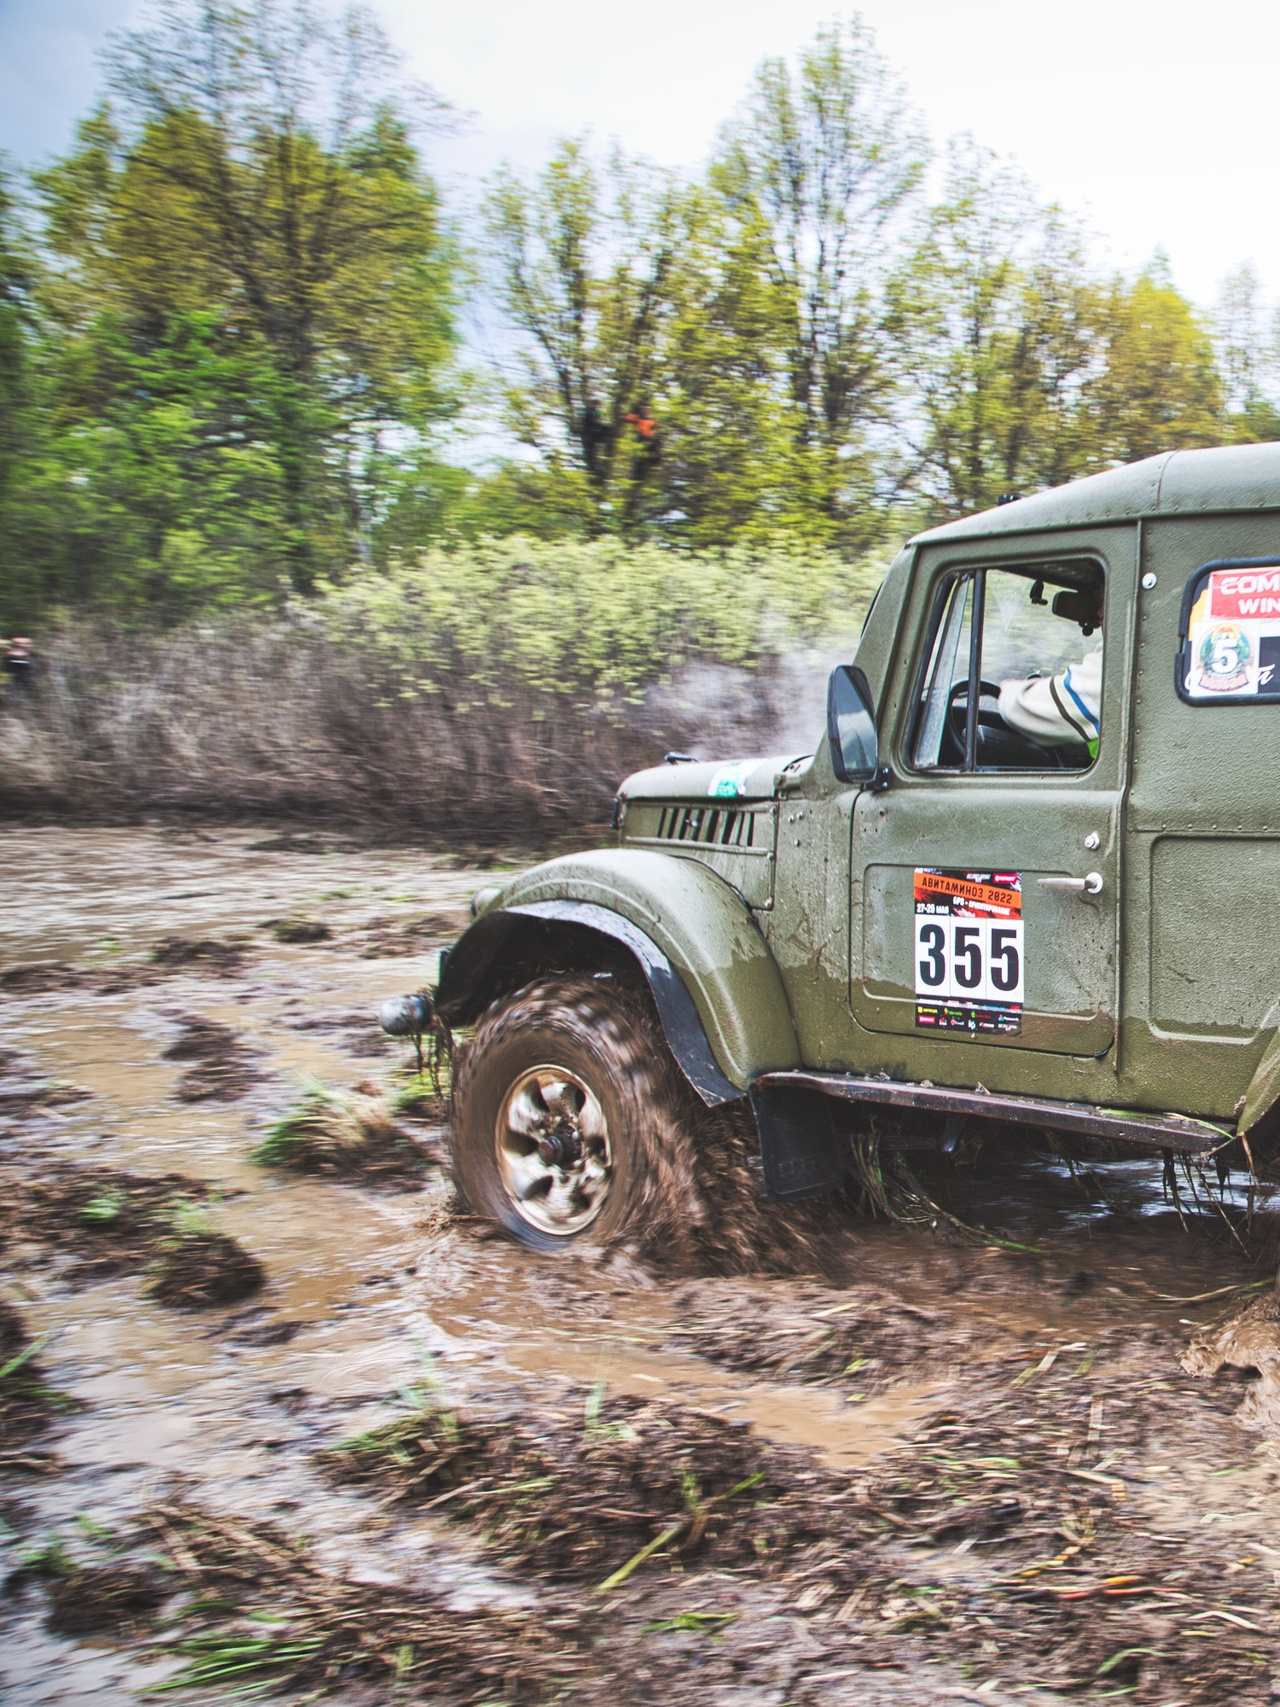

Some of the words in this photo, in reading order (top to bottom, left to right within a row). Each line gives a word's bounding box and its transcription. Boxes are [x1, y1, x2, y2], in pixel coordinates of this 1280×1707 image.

[1211, 638, 1239, 674] 5
[921, 876, 984, 898] АВИТАМИНОЗ
[987, 890, 1013, 905] 2022
[919, 923, 1020, 992] 355
